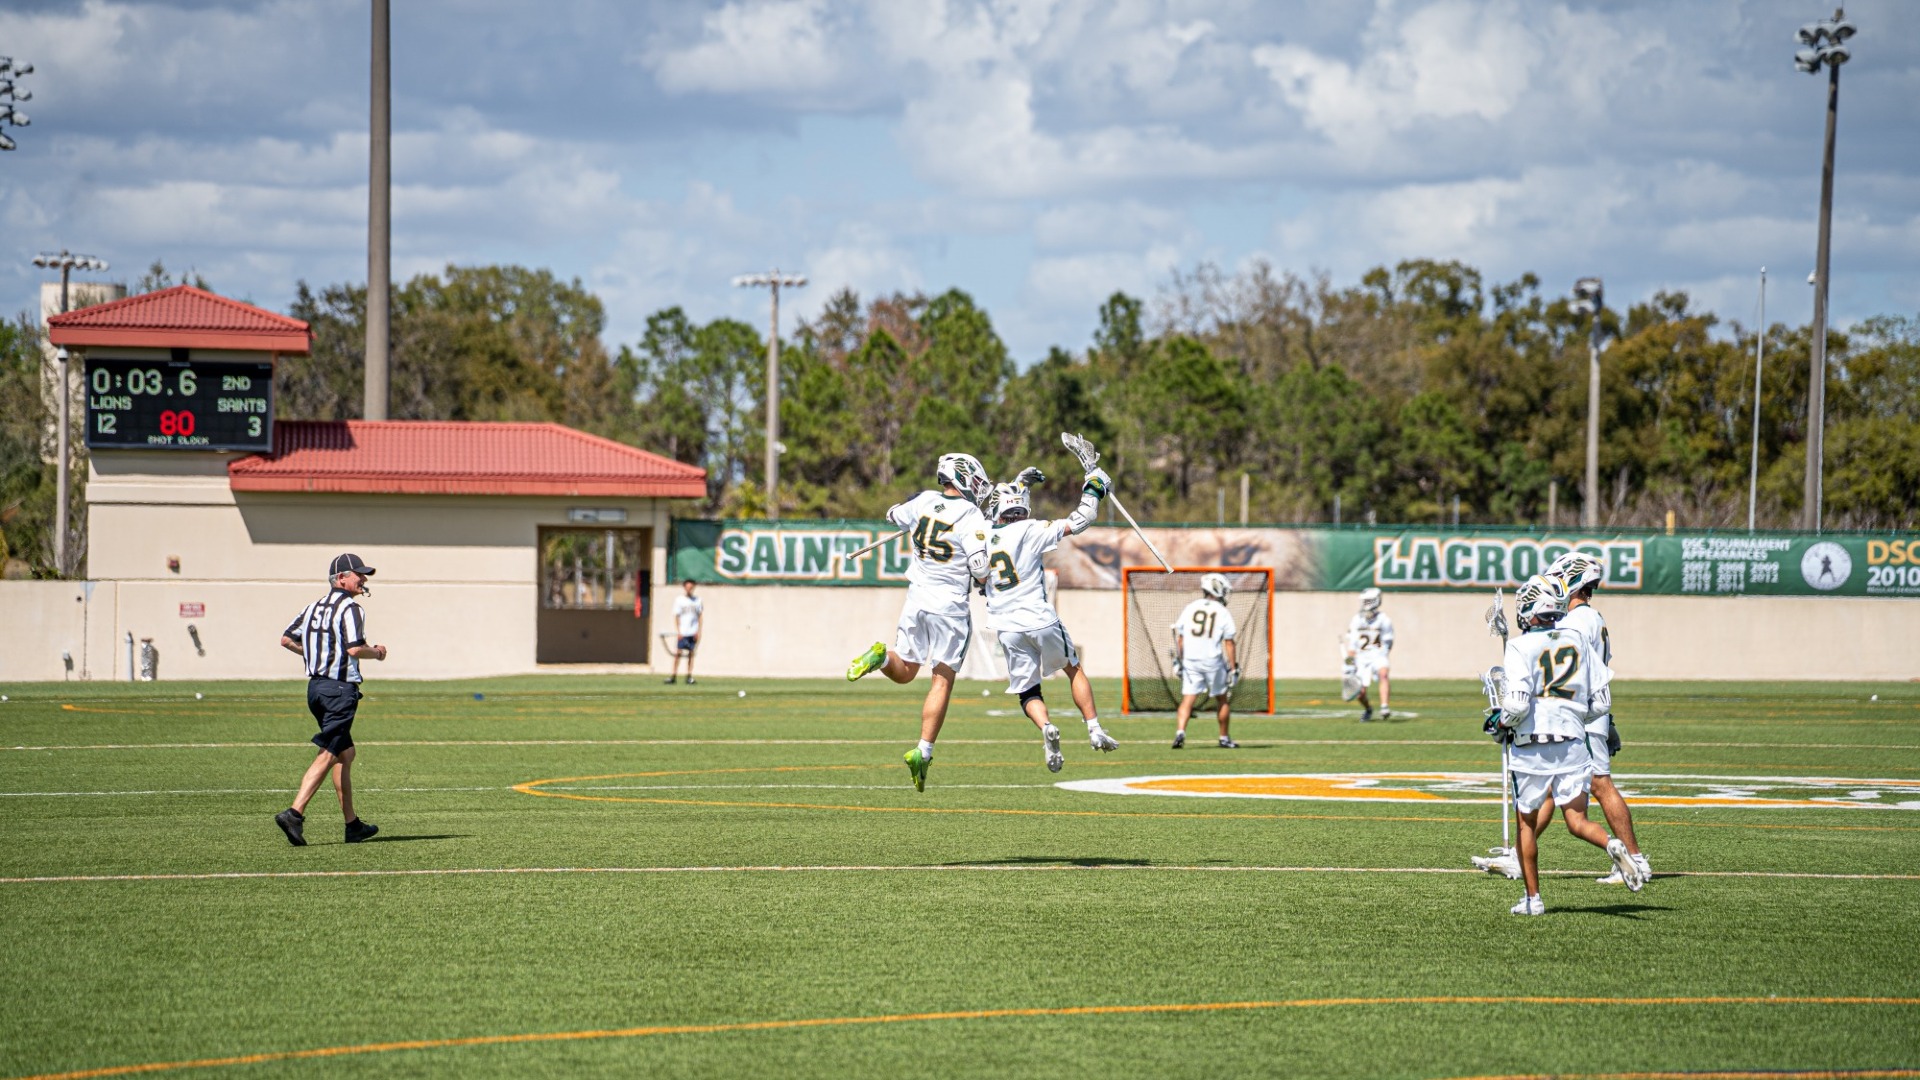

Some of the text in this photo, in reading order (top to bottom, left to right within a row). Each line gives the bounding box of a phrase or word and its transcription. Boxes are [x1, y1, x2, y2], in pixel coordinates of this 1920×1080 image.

[92, 368, 251, 396] 0:03.6 2ND
[90, 395, 267, 412] LIONS SAINTS
[97, 410, 262, 437] 12 80 3
[912, 515, 954, 564] 45
[1867, 540, 1920, 565] DSC
[715, 529, 872, 580] SAINT
[1682, 549, 1768, 560] APPEARANCES
[989, 551, 1019, 591] 3
[1867, 566, 1920, 586] 2010
[311, 605, 332, 630] 50
[1191, 610, 1216, 638] 91
[1360, 634, 1382, 651] 24
[1536, 645, 1579, 699] 12
